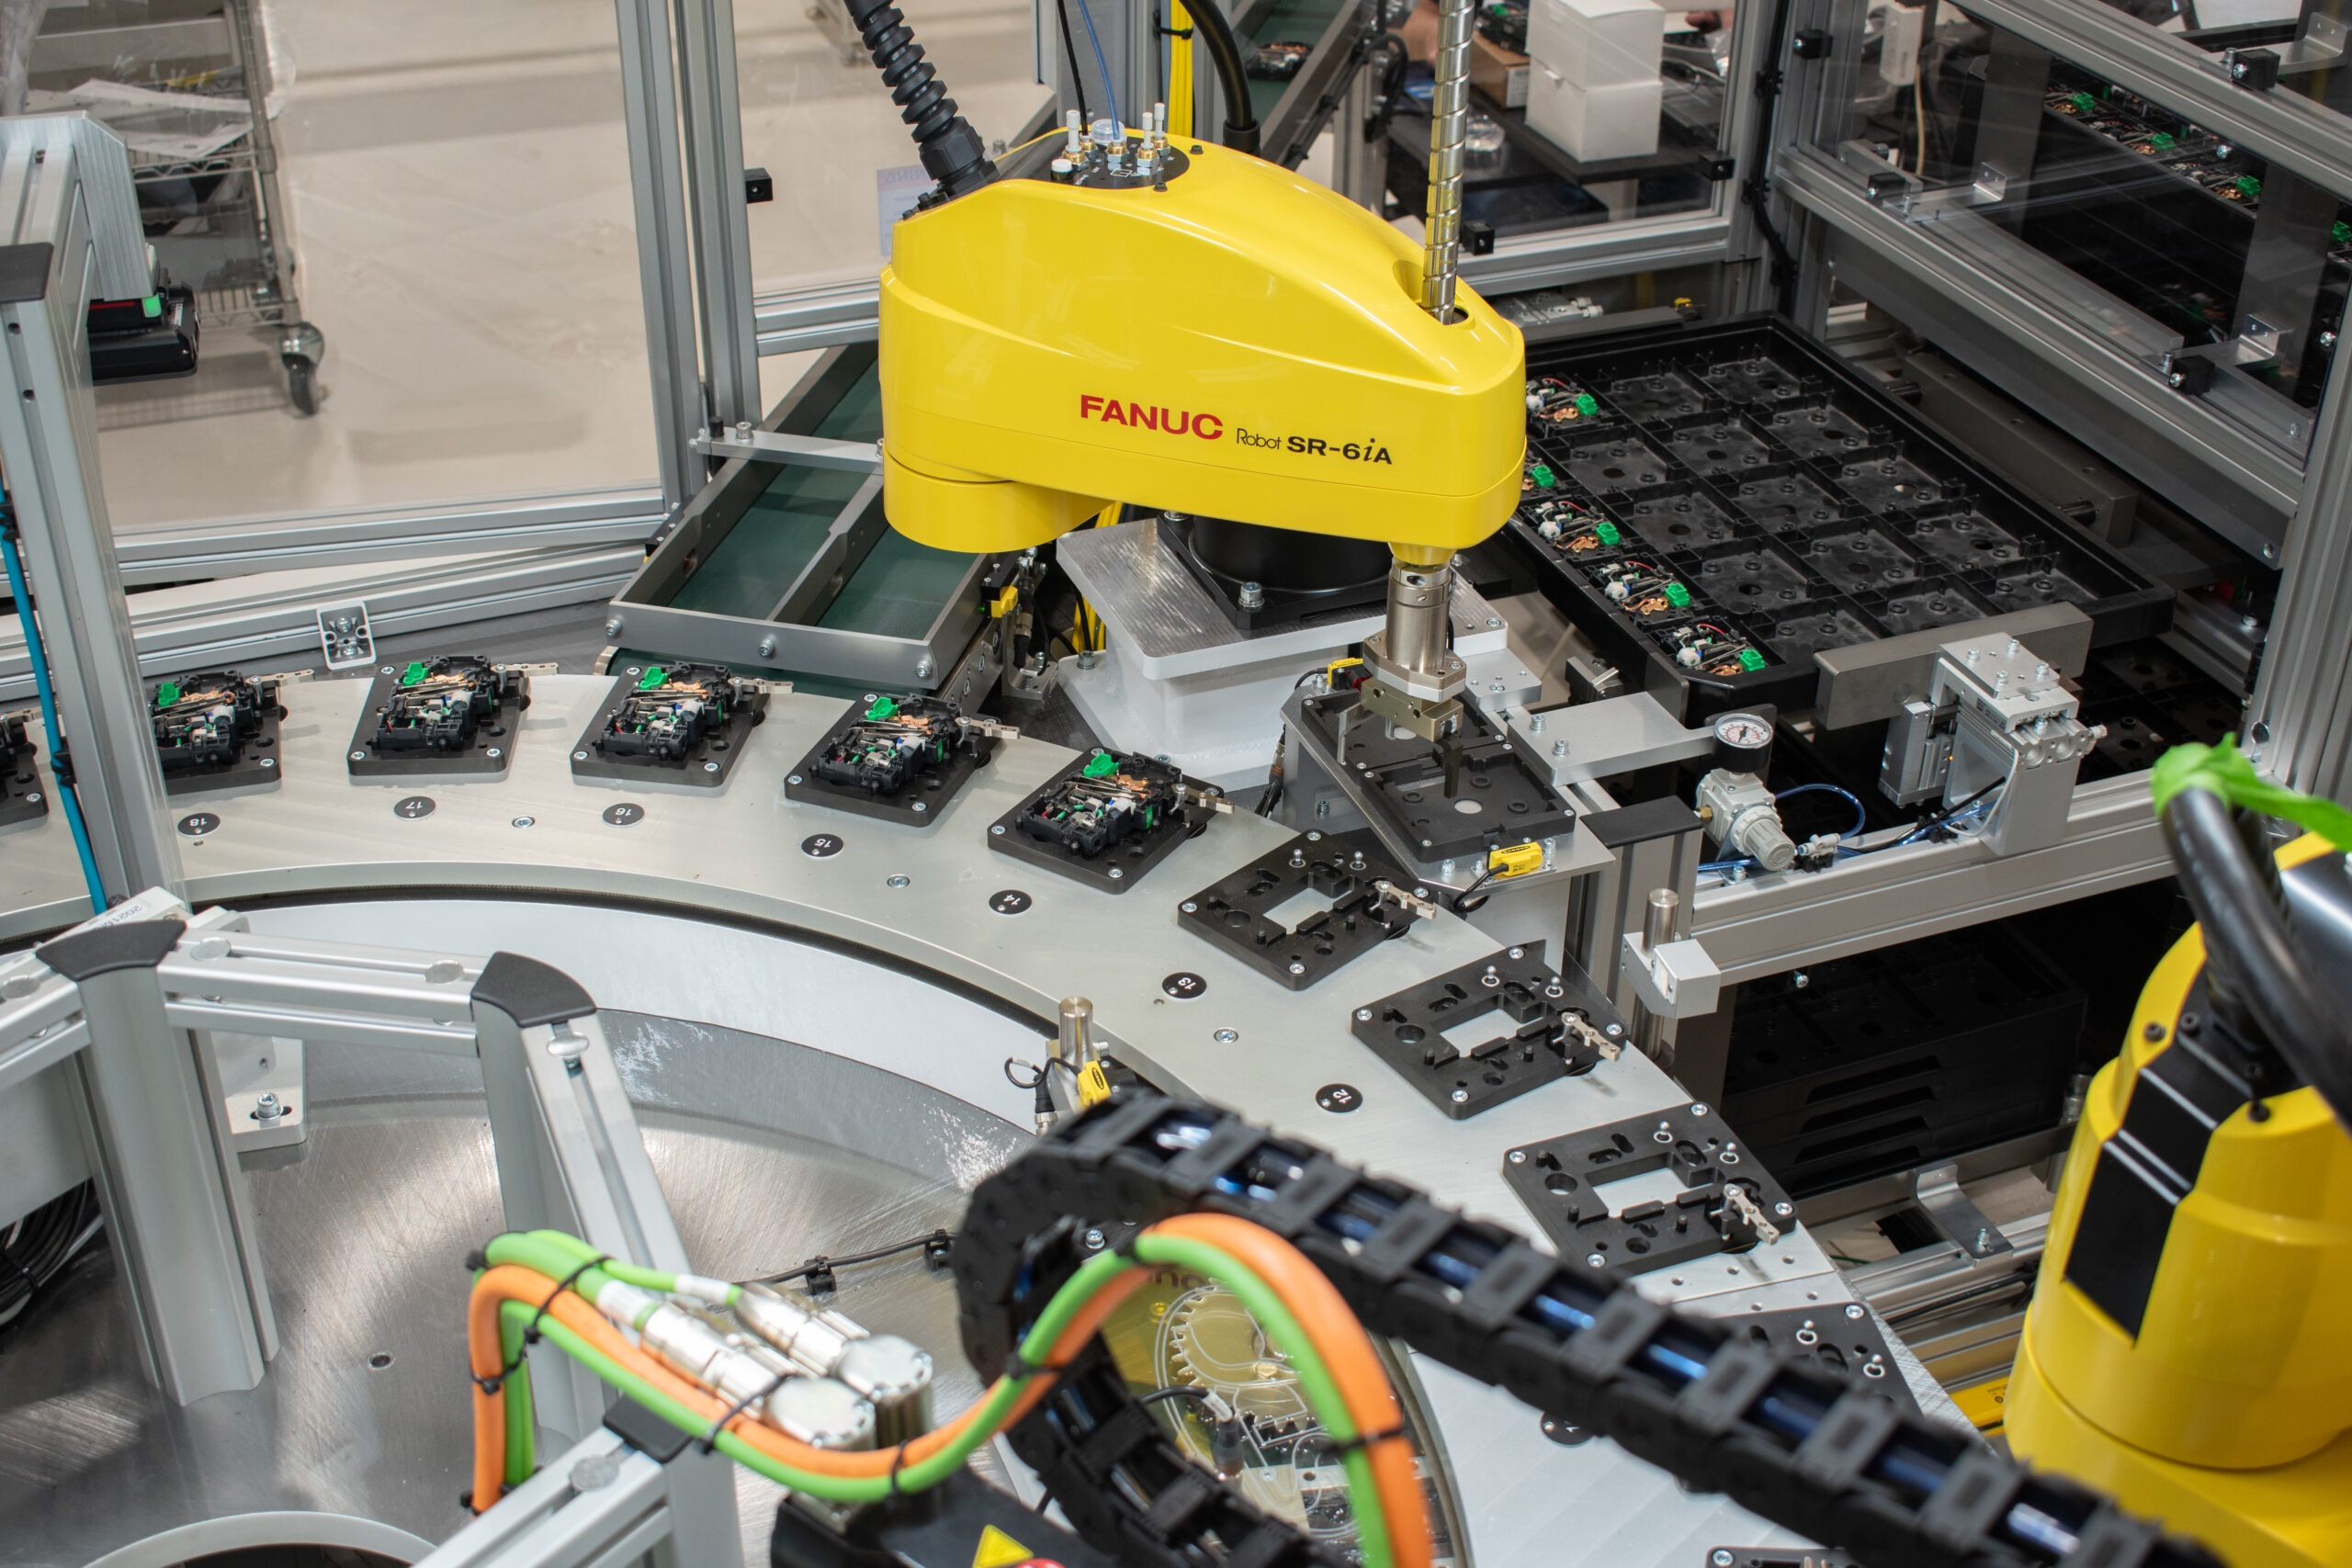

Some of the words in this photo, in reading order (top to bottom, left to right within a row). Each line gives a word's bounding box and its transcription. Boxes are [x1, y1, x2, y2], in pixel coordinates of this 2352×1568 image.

[1080, 394, 1224, 440] FANUC
[1236, 427, 1283, 450] Robot
[1286, 435, 1393, 465] SR-6iA
[404, 800, 424, 809] 17
[615, 807, 633, 817] 16
[188, 818, 209, 827] 18
[814, 838, 832, 849] 15
[1002, 894, 1021, 906] 14
[1177, 976, 1196, 990] 13
[1332, 1089, 1352, 1104] 12
